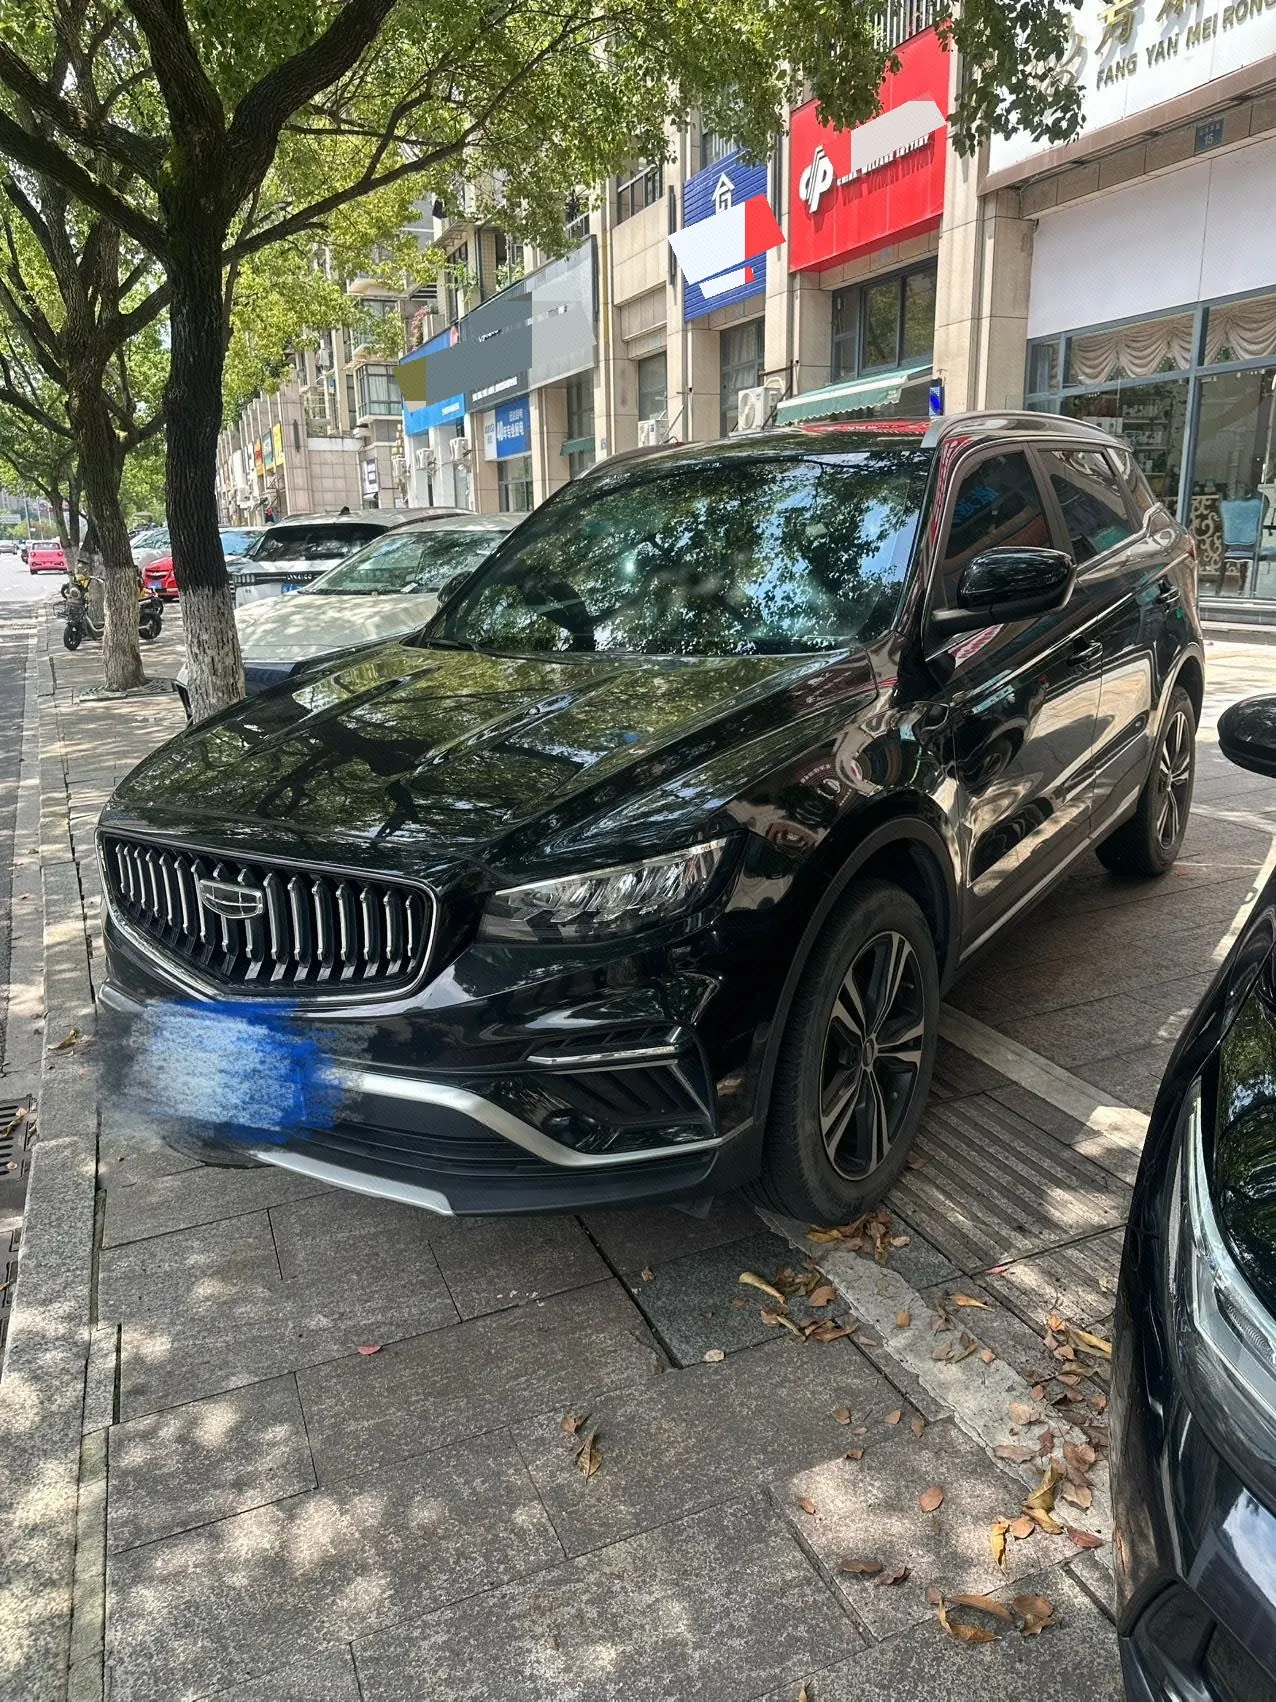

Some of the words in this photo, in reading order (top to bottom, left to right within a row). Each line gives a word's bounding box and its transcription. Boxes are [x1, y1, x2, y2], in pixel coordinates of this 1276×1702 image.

[1096, 53, 1138, 91] FANG
[1146, 32, 1180, 69] YAN
[1186, 13, 1219, 50] MEI
[1204, 133, 1214, 145] 15
